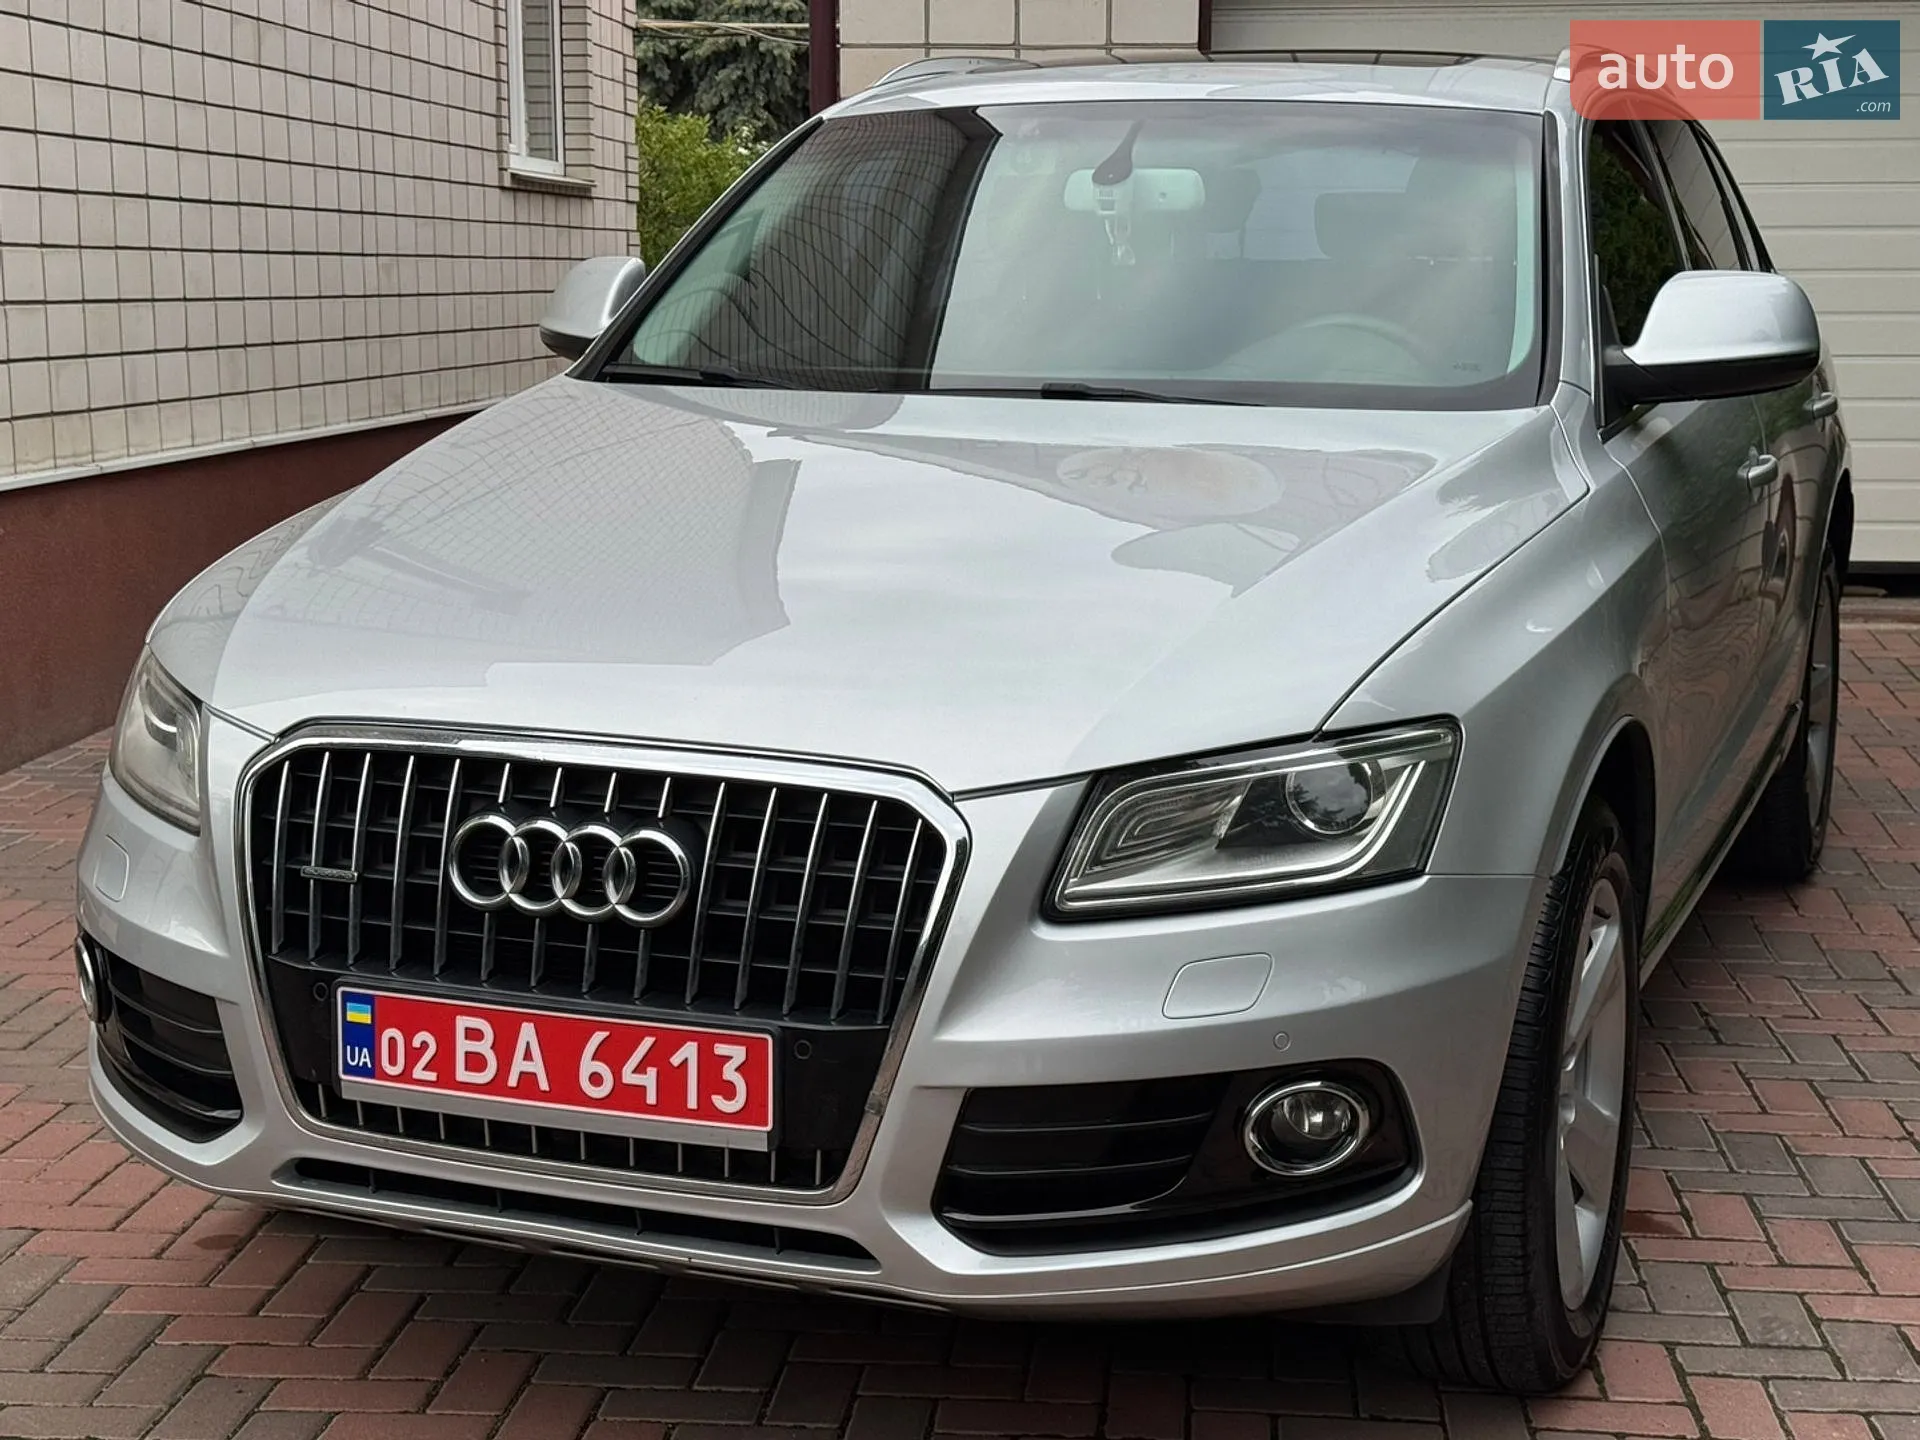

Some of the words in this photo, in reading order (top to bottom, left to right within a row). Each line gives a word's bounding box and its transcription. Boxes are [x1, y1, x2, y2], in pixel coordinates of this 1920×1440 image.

[346, 1045, 372, 1069] UA
[380, 1027, 438, 1082] 02
[455, 1015, 550, 1092] BA
[579, 1031, 748, 1114] 6413
